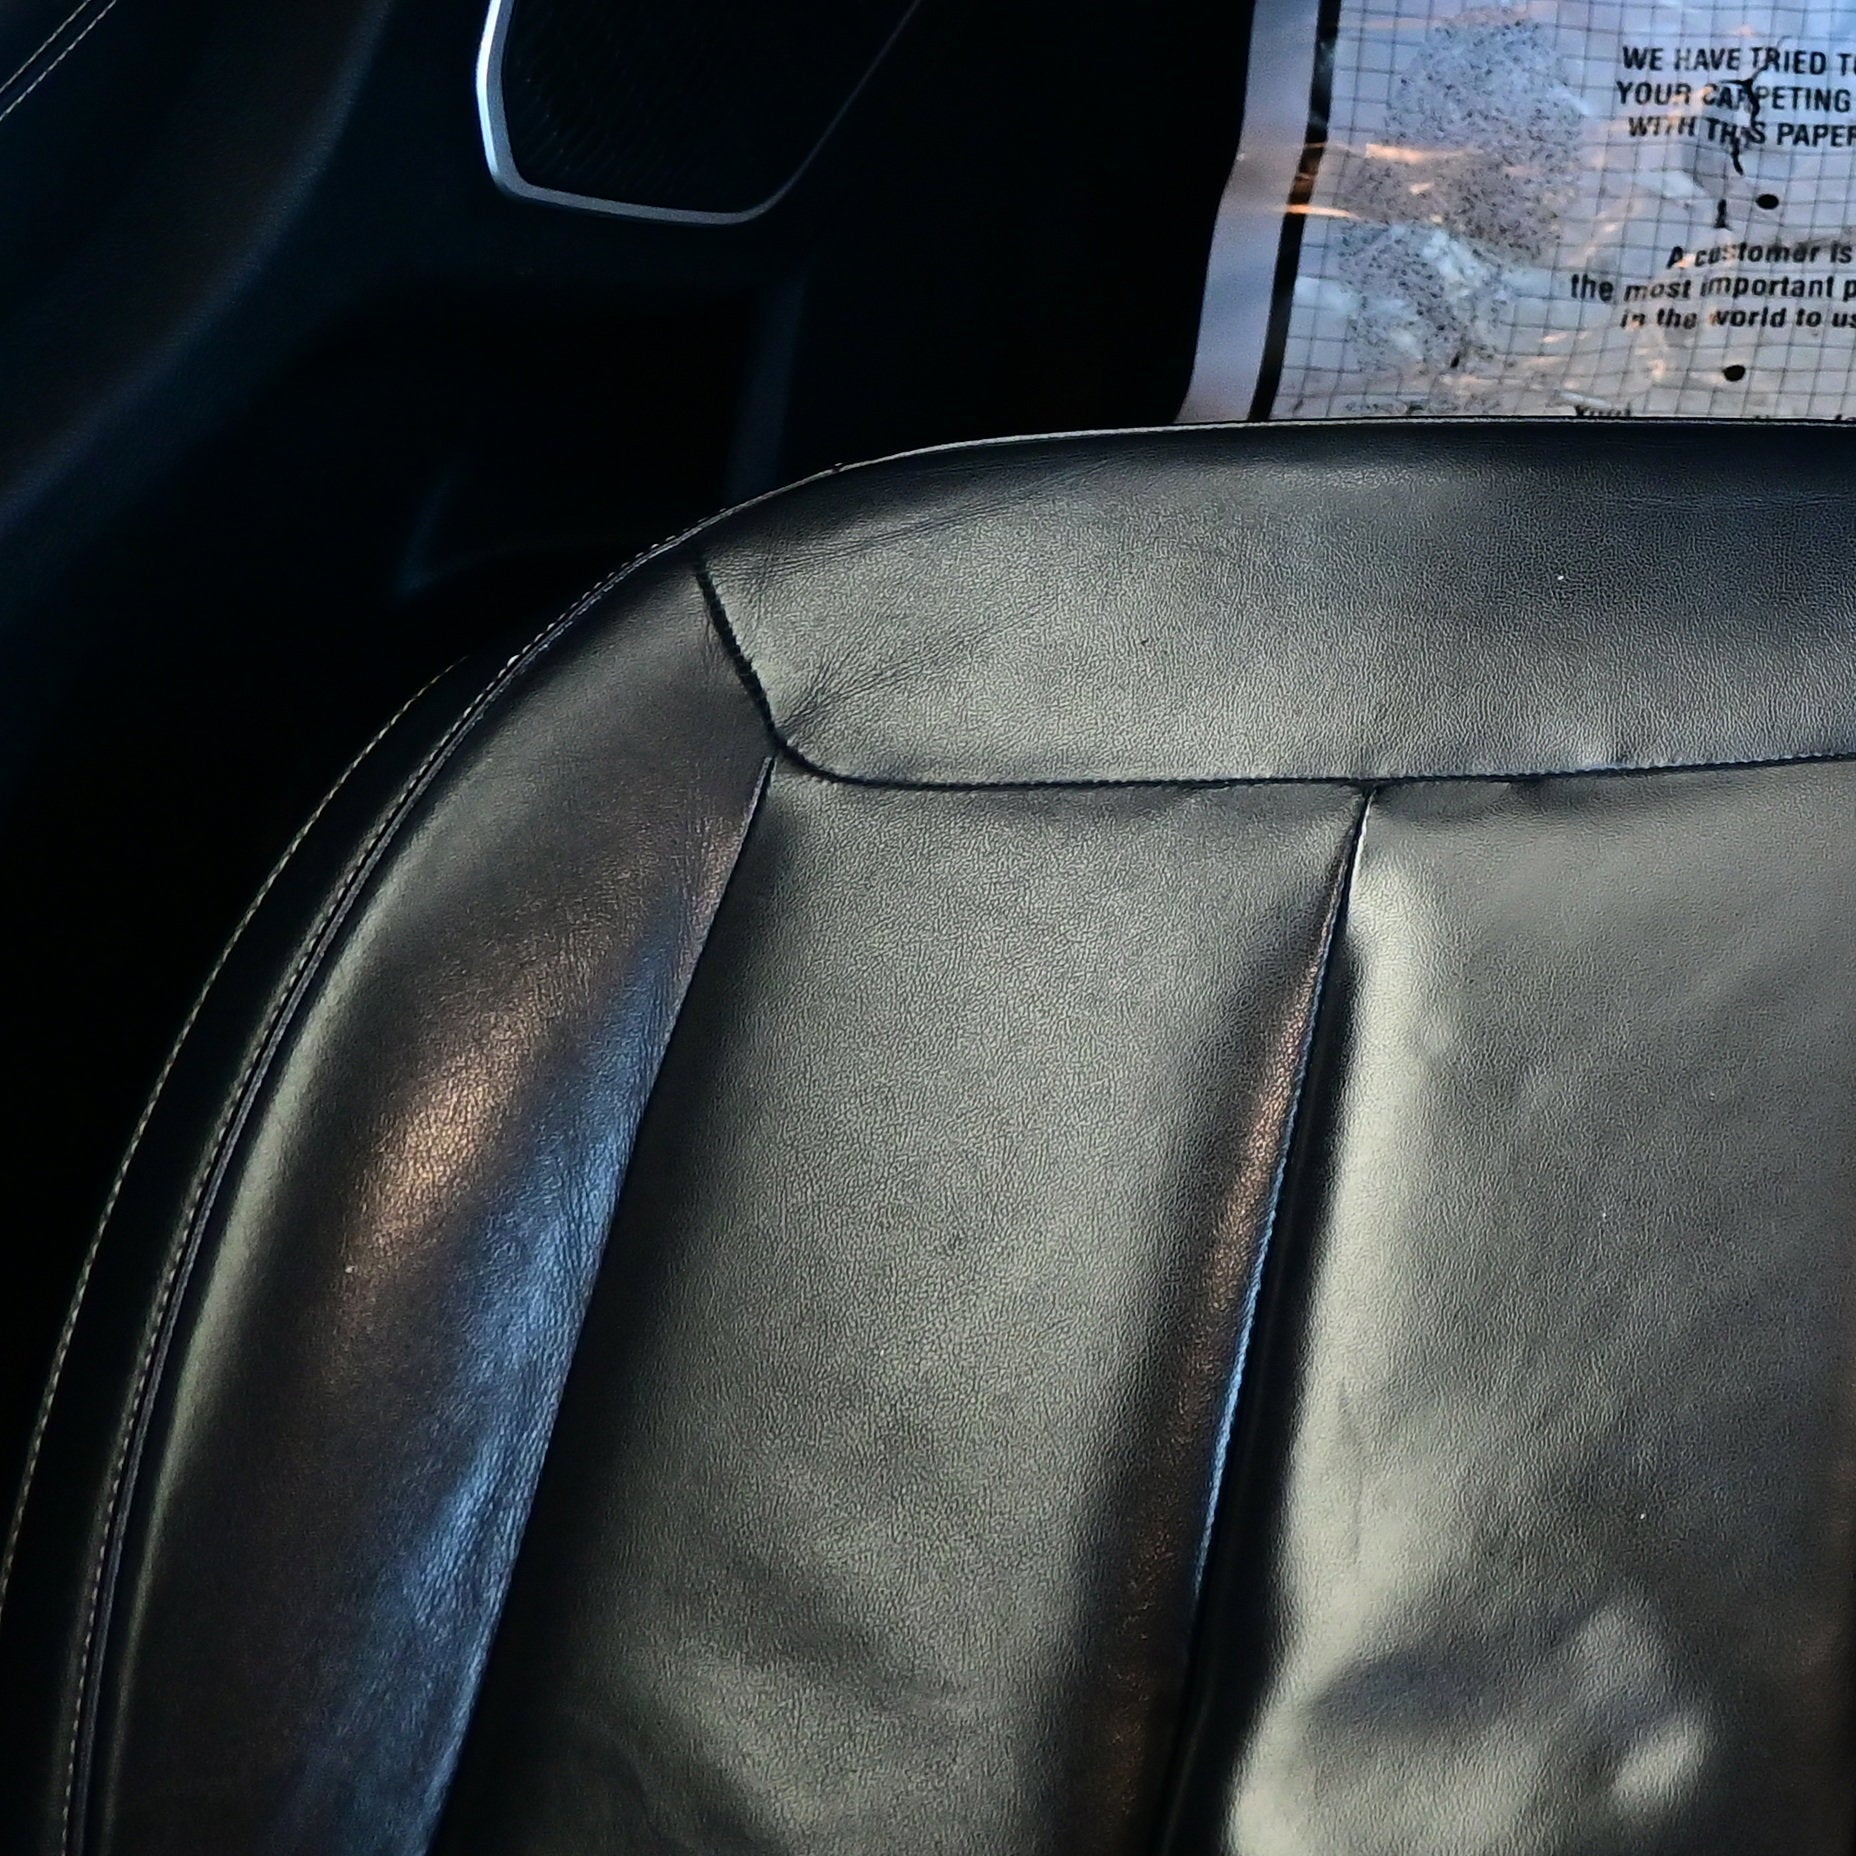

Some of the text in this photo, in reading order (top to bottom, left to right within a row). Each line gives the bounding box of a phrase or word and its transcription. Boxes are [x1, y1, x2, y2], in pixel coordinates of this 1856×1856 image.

[1623, 46, 1664, 71] WE
[1674, 47, 1741, 72] HAVE
[1752, 46, 1827, 75] TRIED
[1616, 81, 1691, 106] YOUR
[1628, 116, 1696, 138] WITH
[1666, 242, 1853, 269] A customer is
[1570, 274, 1614, 303] the
[1623, 279, 1692, 302] most
[1700, 274, 1834, 300] important
[1620, 309, 1646, 330] in
[1656, 307, 1697, 331] the
[1709, 306, 1786, 330] world
[1796, 307, 1821, 329] to
